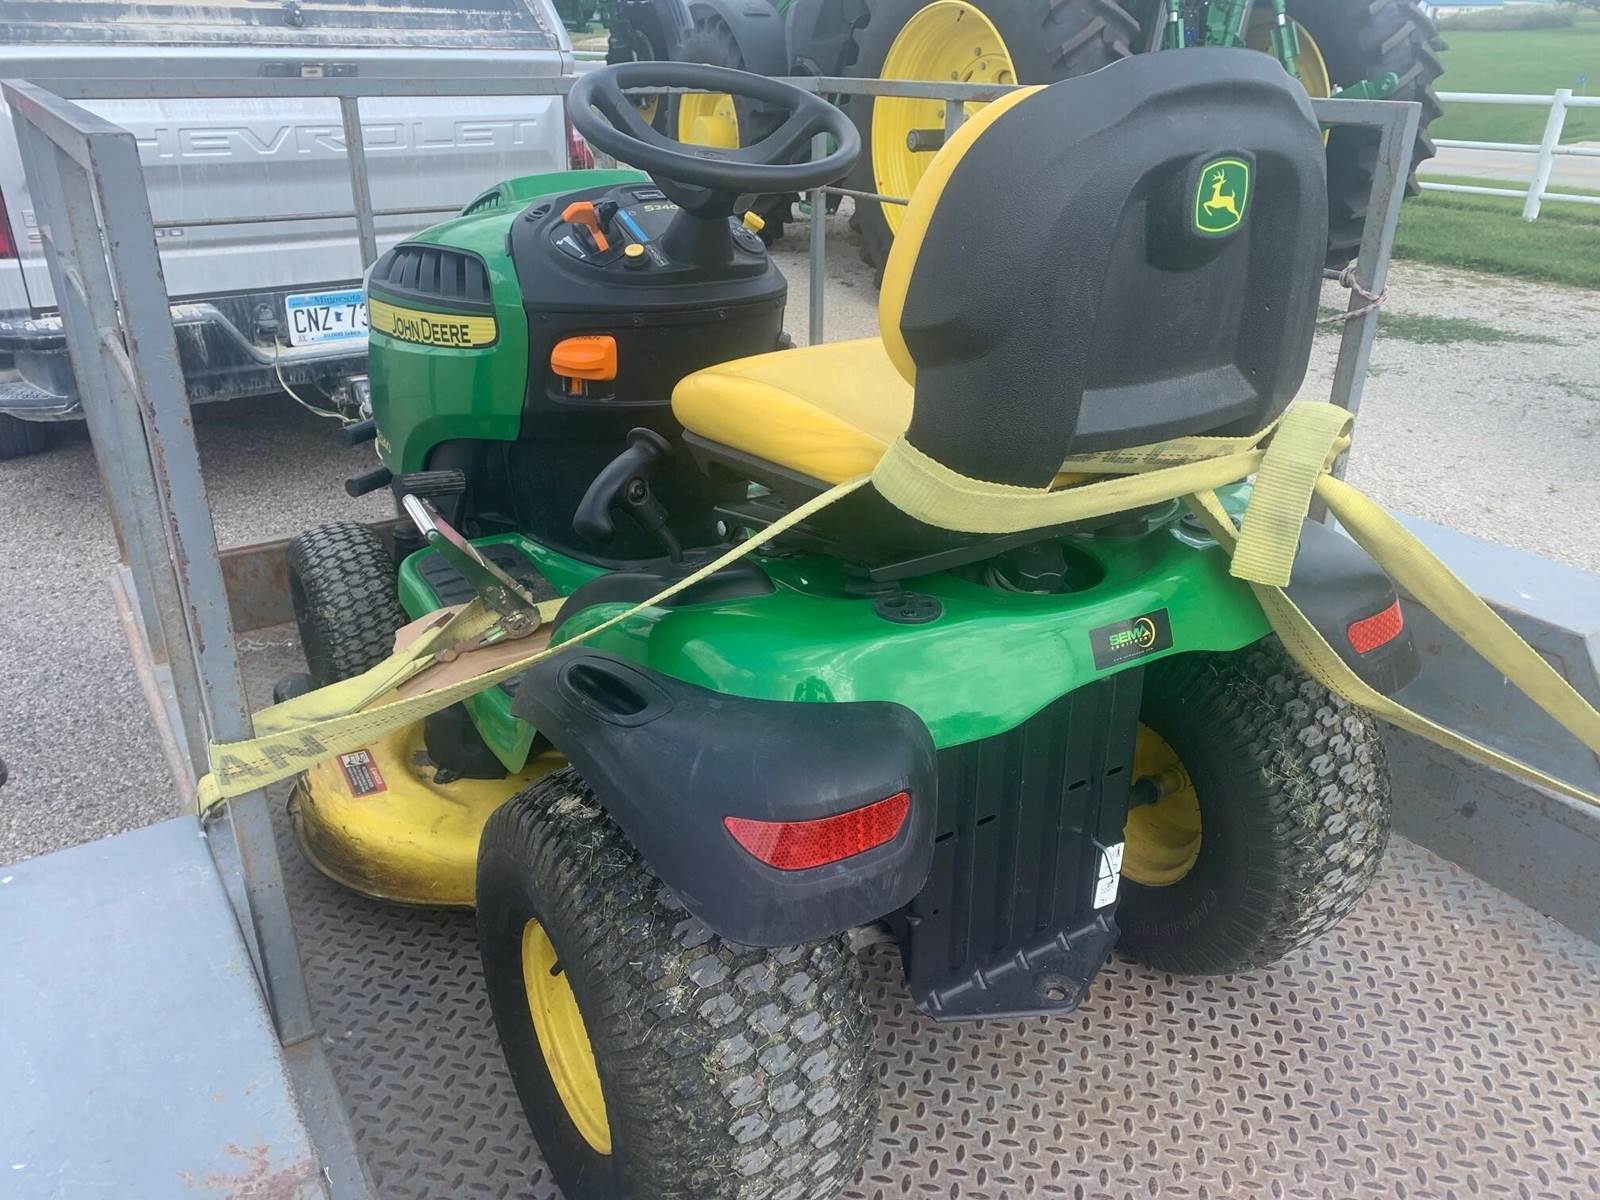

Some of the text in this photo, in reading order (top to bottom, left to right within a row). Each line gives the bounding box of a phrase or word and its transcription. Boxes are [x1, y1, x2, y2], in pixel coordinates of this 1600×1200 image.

[137, 118, 537, 158] HEVROLET
[293, 306, 332, 333] CNZ
[392, 312, 471, 343] JOHN DEERE
[1109, 624, 1151, 646] SEMA
